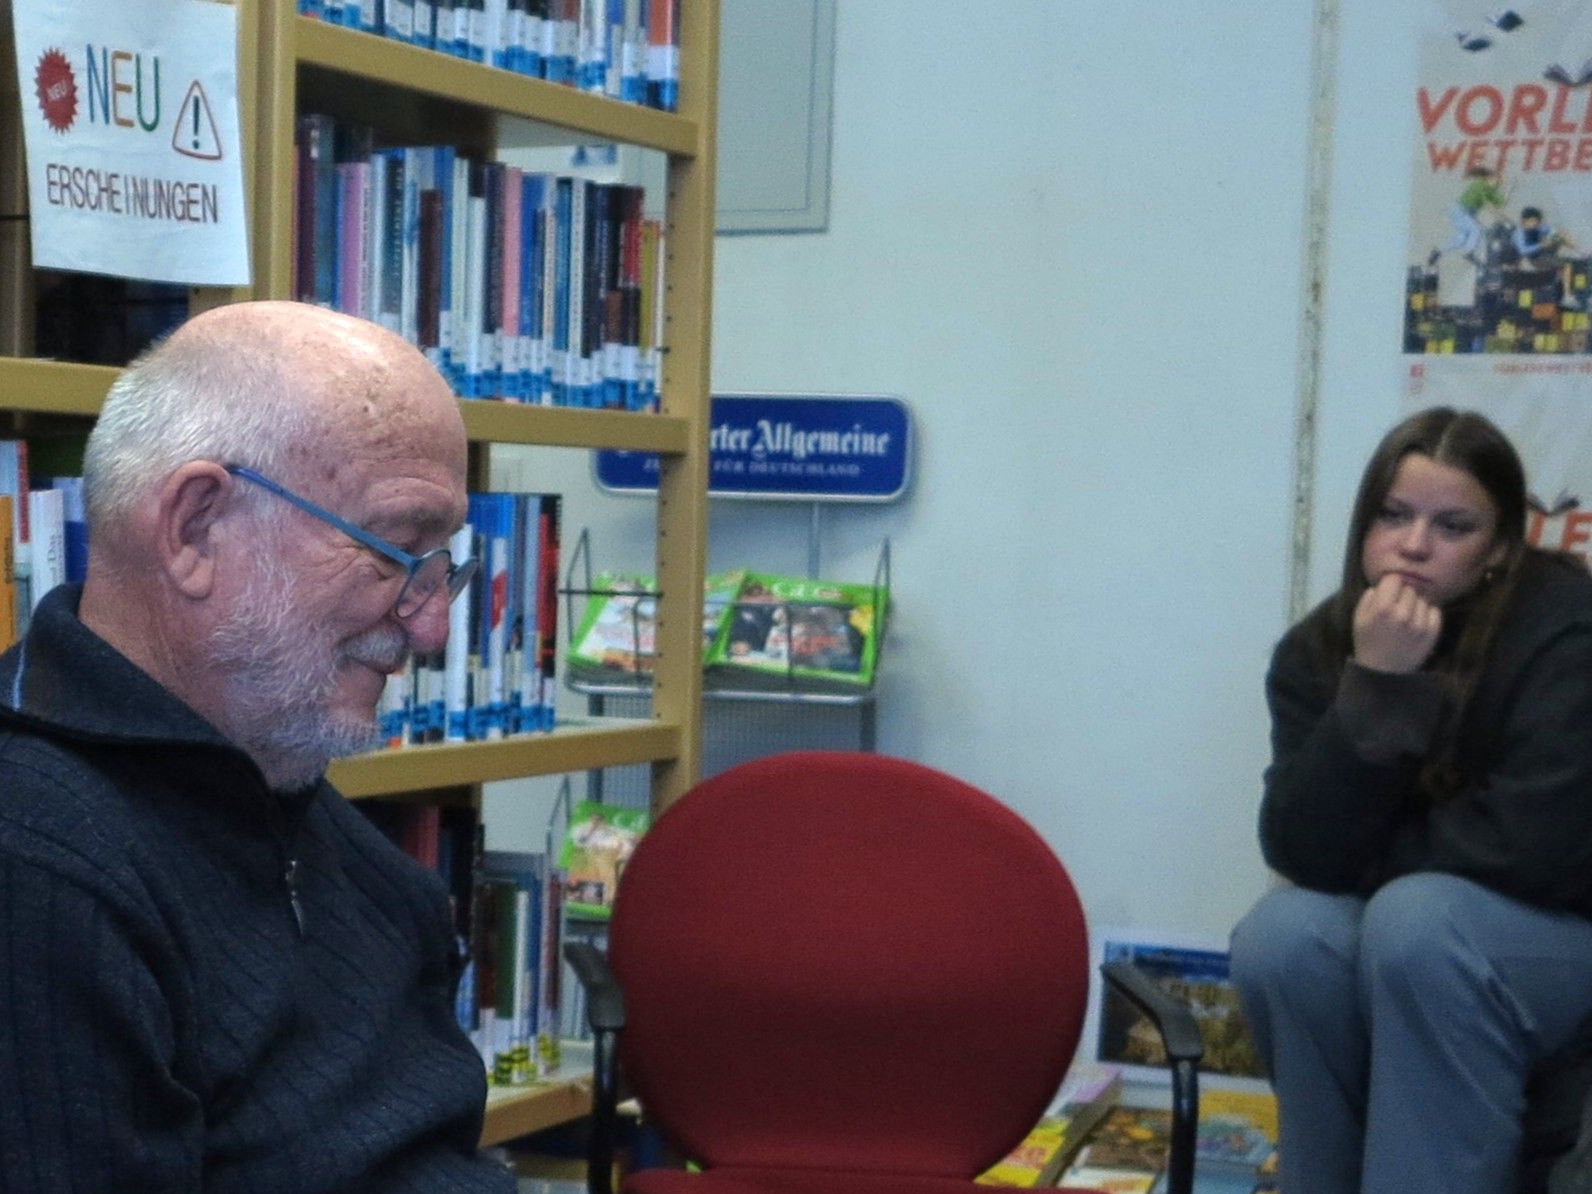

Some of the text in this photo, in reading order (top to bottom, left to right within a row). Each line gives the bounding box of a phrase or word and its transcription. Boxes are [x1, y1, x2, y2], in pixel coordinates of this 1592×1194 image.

[85, 43, 161, 133] NEU
[45, 163, 219, 224] ERSCHEINUNGEN
[750, 419, 891, 460] Allgemeine
